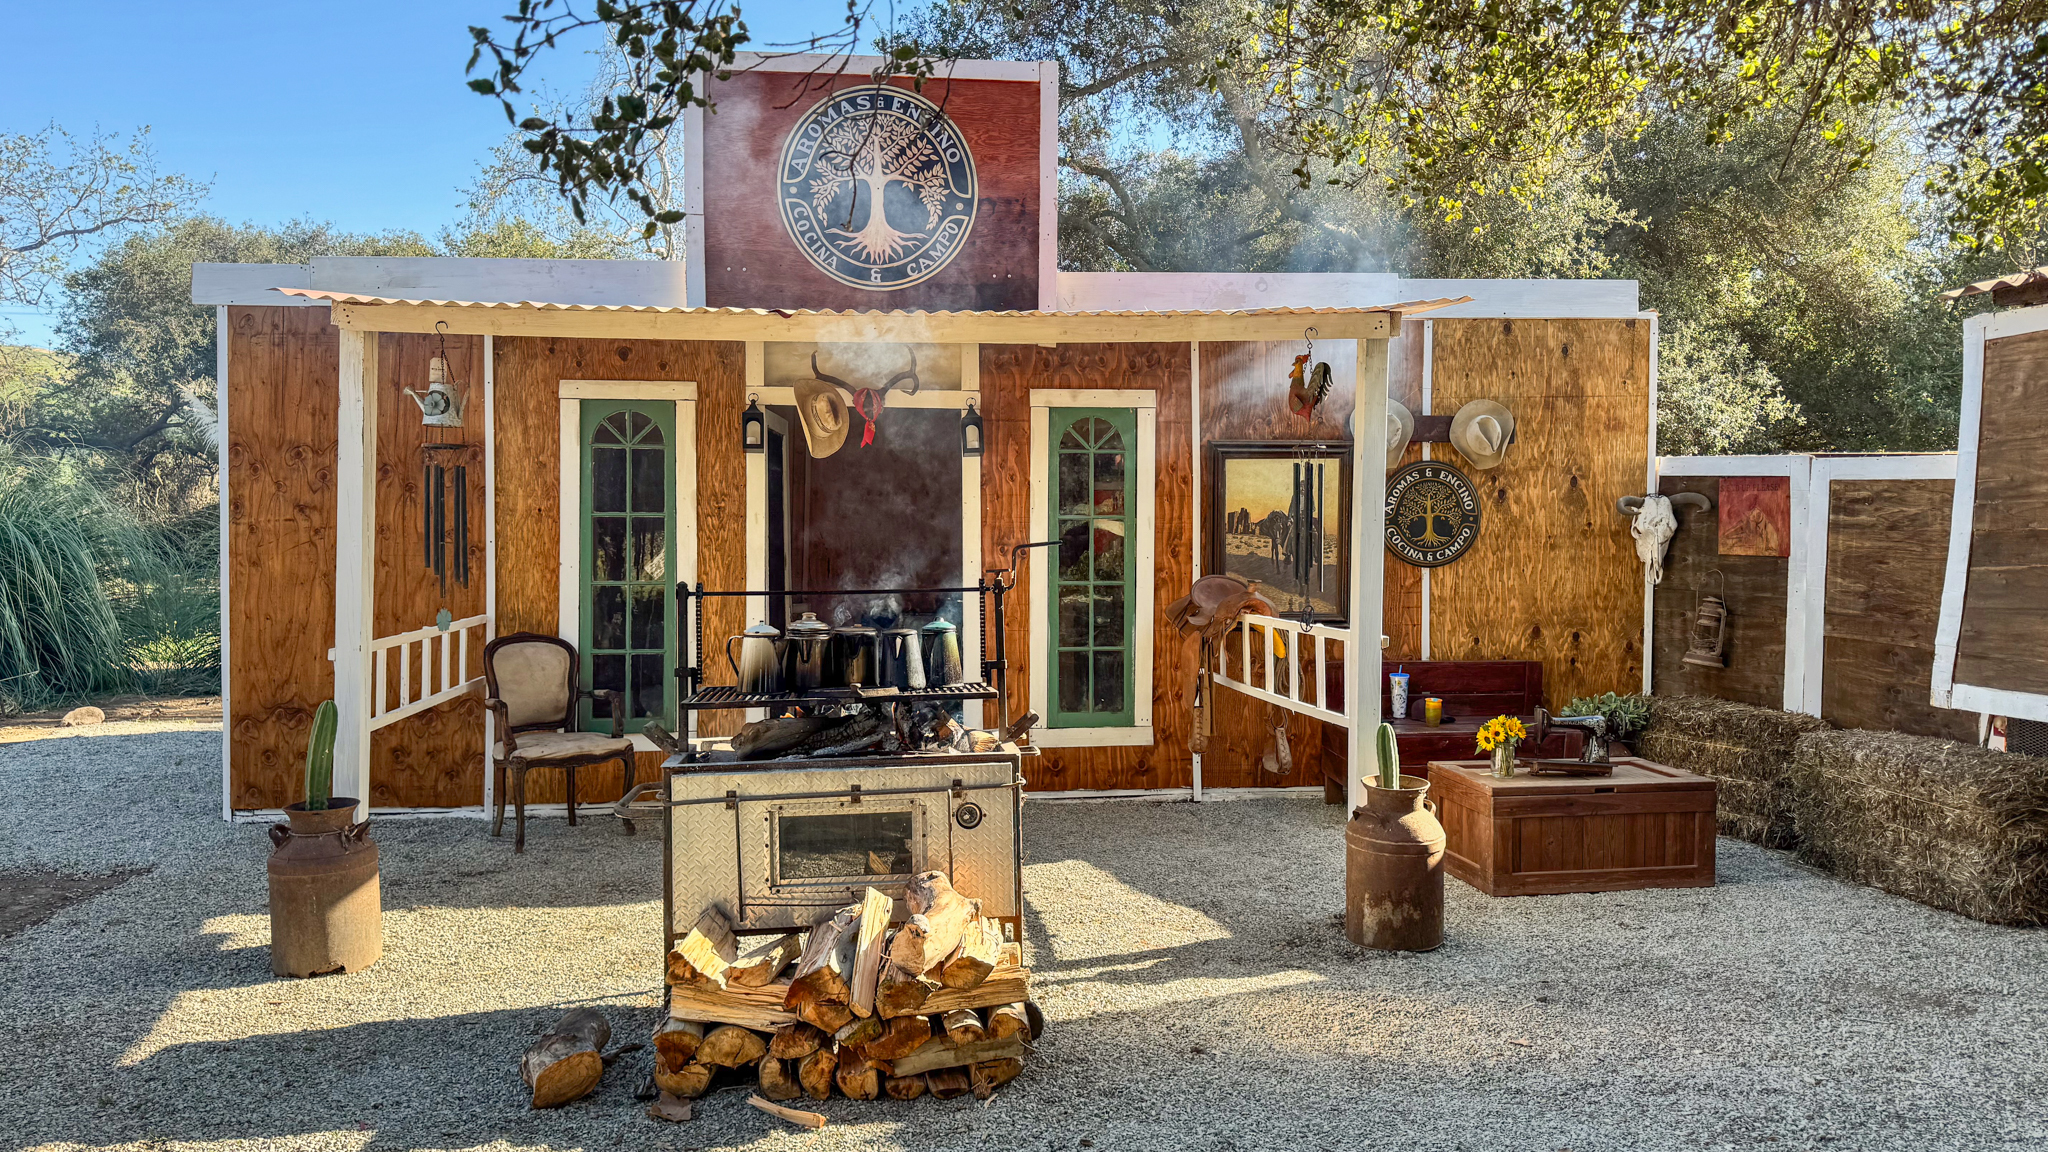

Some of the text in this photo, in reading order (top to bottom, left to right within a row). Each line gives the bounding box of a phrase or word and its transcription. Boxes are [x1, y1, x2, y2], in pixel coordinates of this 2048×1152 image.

[790, 96, 961, 174] AROMAS & ENINO
[793, 206, 959, 283] COCINA & CAMPO
[1385, 468, 1474, 514] AROMAS & ENCINO
[1386, 528, 1471, 561] COCINA & CAMPO
